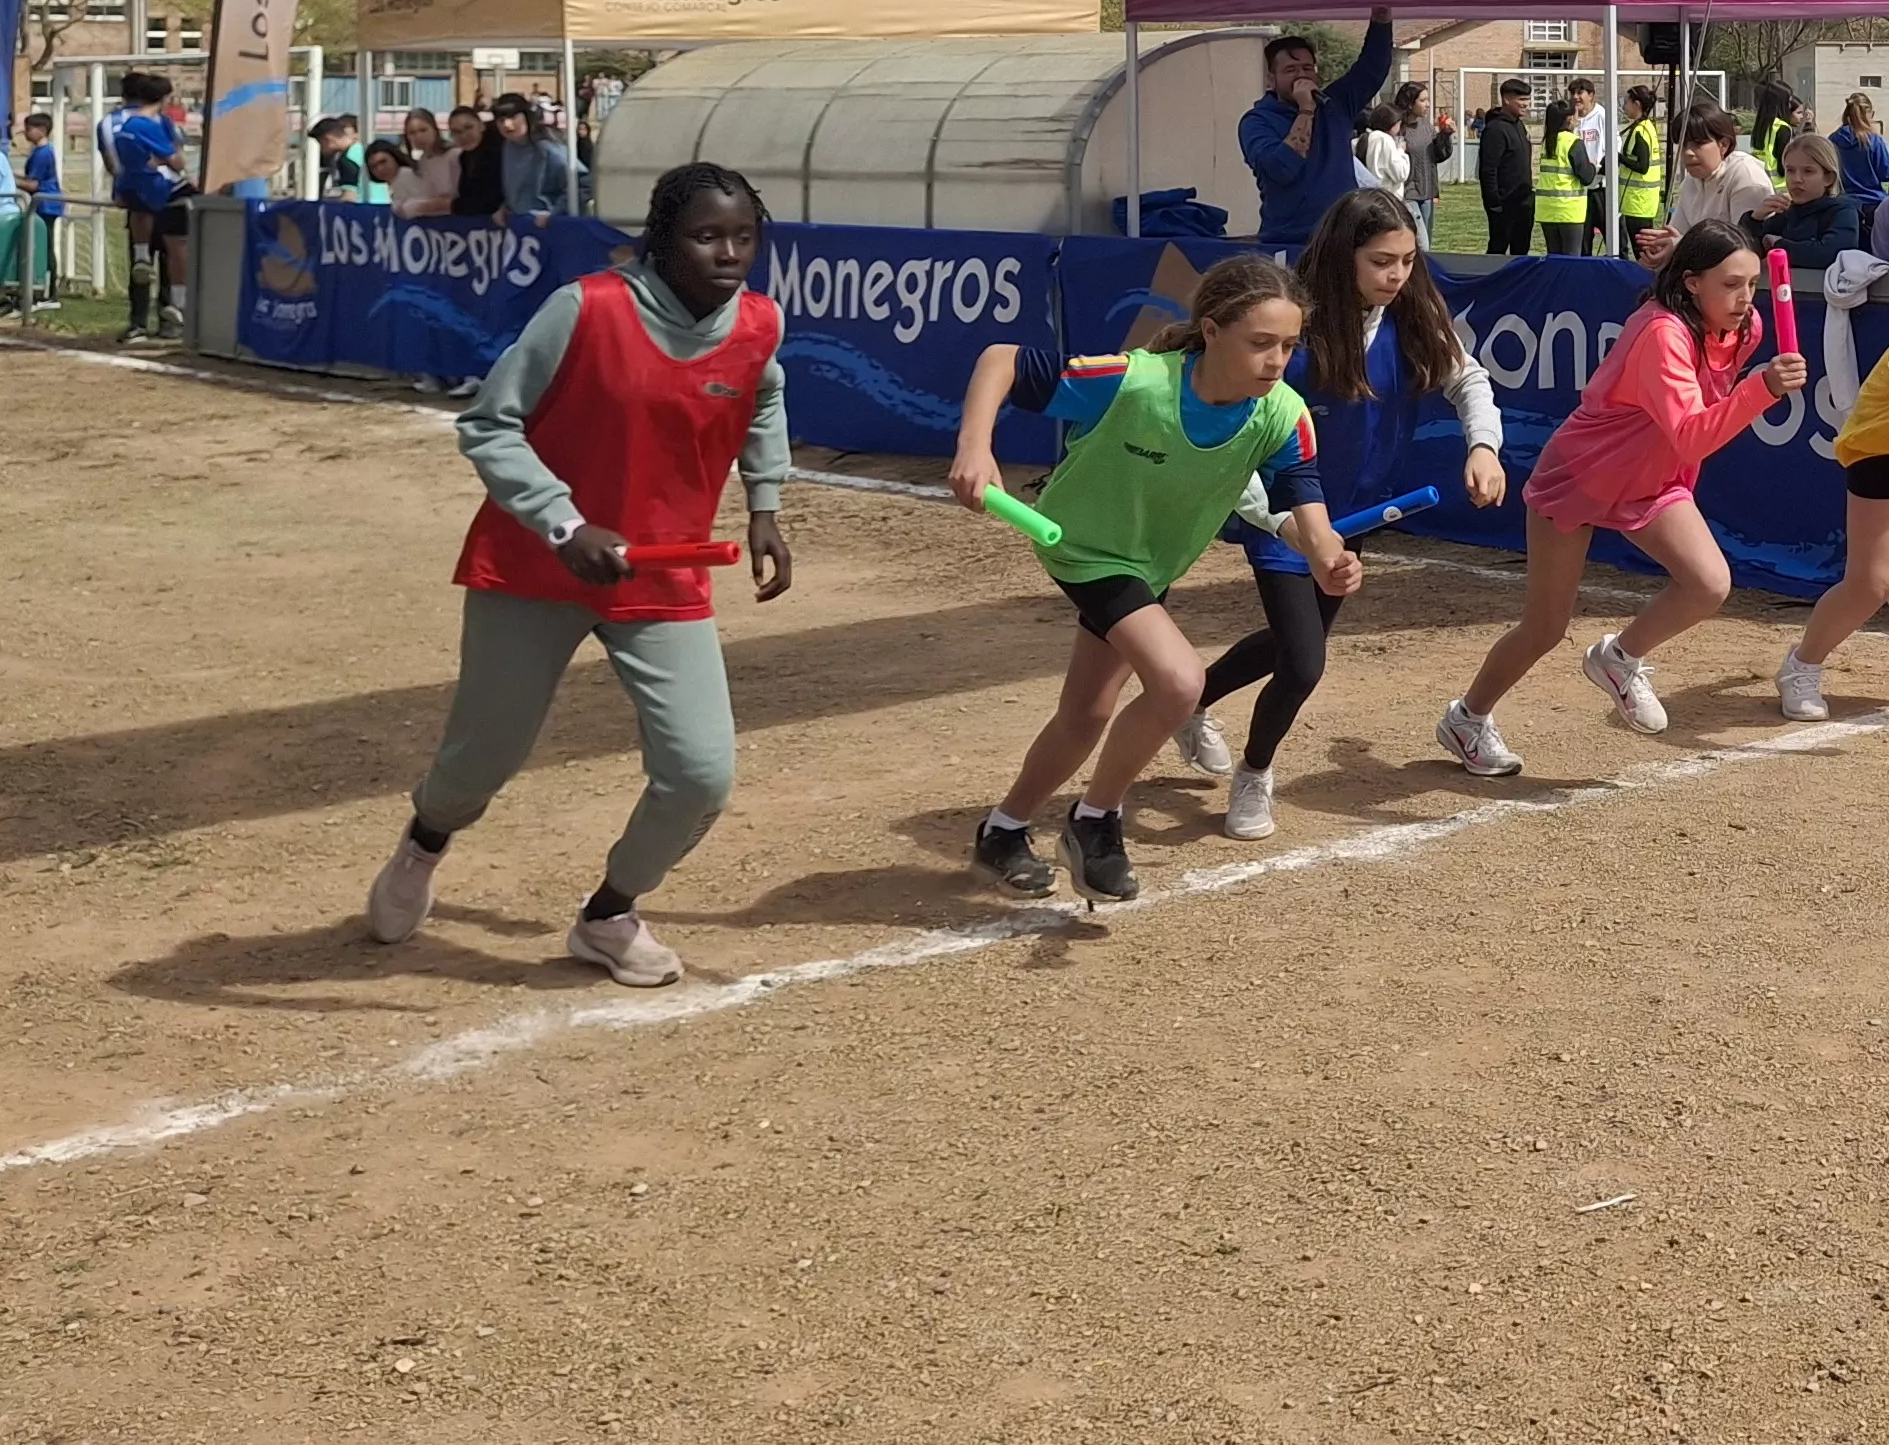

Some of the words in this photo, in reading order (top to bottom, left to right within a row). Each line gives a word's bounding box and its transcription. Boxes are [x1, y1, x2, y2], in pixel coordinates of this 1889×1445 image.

[317, 204, 369, 267] Los
[372, 213, 543, 296] Monegros
[766, 240, 1022, 344] Monegros
